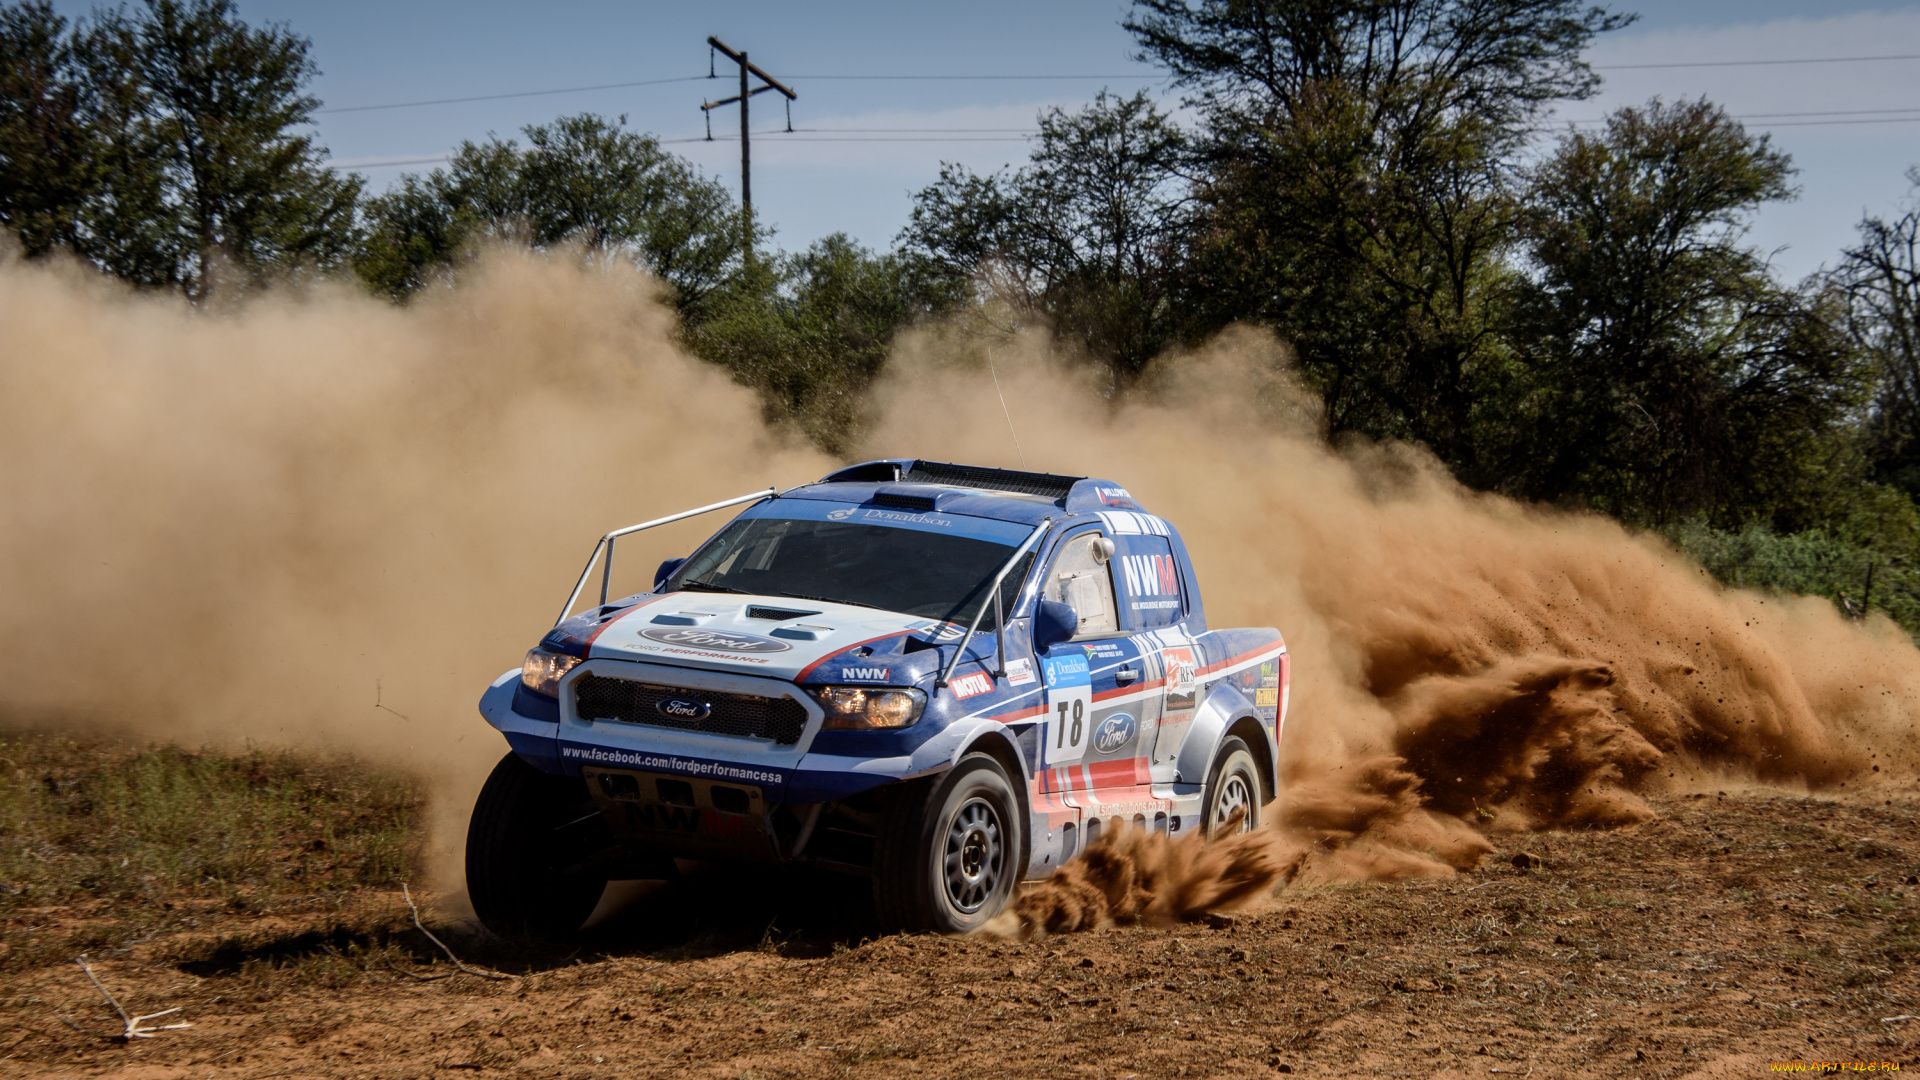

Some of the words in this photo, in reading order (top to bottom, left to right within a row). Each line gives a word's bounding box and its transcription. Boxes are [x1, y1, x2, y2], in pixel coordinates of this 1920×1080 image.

[863, 509, 951, 527] Donaldson
[1122, 555, 1177, 597] NWM
[663, 629, 761, 650] Ford
[623, 643, 660, 652] FORD
[662, 647, 770, 664] PERFORMANCE
[842, 667, 890, 680] NWM
[1056, 659, 1088, 675] Donaldson
[1180, 666, 1195, 682] RFS
[952, 674, 991, 698] MOTUL
[667, 700, 696, 717] Ford
[1057, 699, 1084, 749] T8
[1141, 718, 1153, 731] FORD
[1154, 711, 1192, 728] PERFORMANCE
[1100, 718, 1130, 749] Ford
[562, 747, 782, 783] www.facebook.com/fordperformancesa
[1083, 801, 1166, 818] www.signsolutions.co.za
